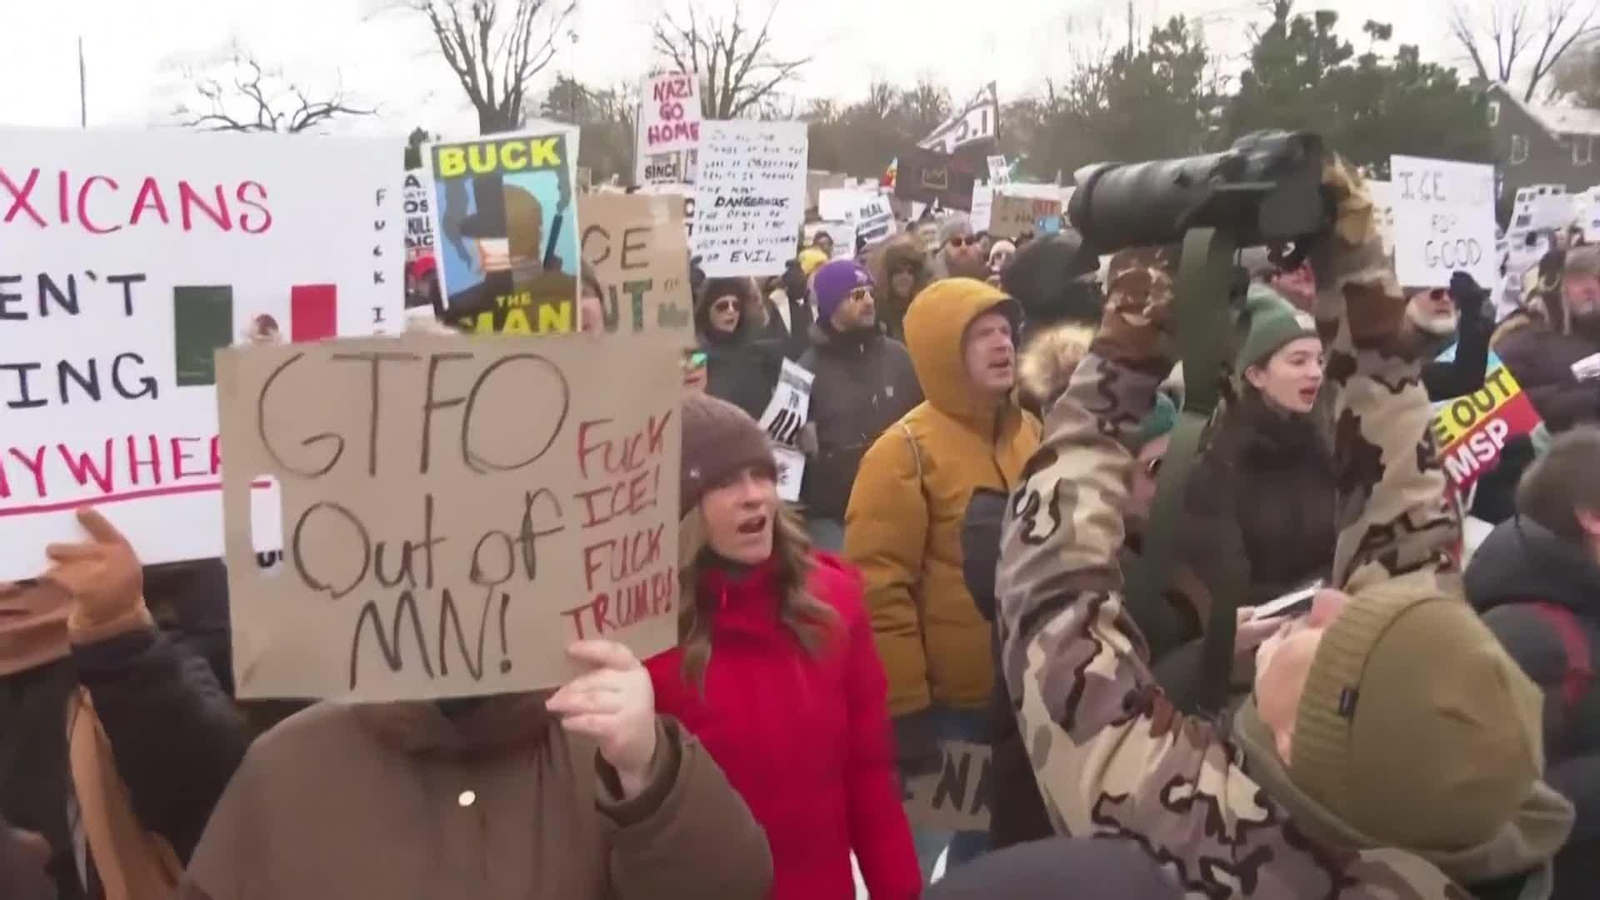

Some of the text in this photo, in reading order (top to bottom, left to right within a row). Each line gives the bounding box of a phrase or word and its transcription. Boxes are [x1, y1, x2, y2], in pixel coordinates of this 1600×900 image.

[653, 77, 693, 101] NAZI
[659, 102, 684, 120] GO
[438, 136, 561, 177] BUCK
[648, 121, 699, 146] HOME
[371, 188, 387, 334] FUCK I
[730, 249, 776, 263] EVIL
[1425, 238, 1482, 268] GOOD
[495, 293, 533, 308] THE
[258, 352, 570, 479] GTFO
[1451, 367, 1511, 427] OUT
[1444, 418, 1508, 483] MSP
[573, 463, 661, 529] ICE!
[293, 488, 566, 600] Out of
[584, 523, 665, 592] FUCK
[560, 566, 673, 640] TRUMP!
[350, 586, 512, 690] MN!
